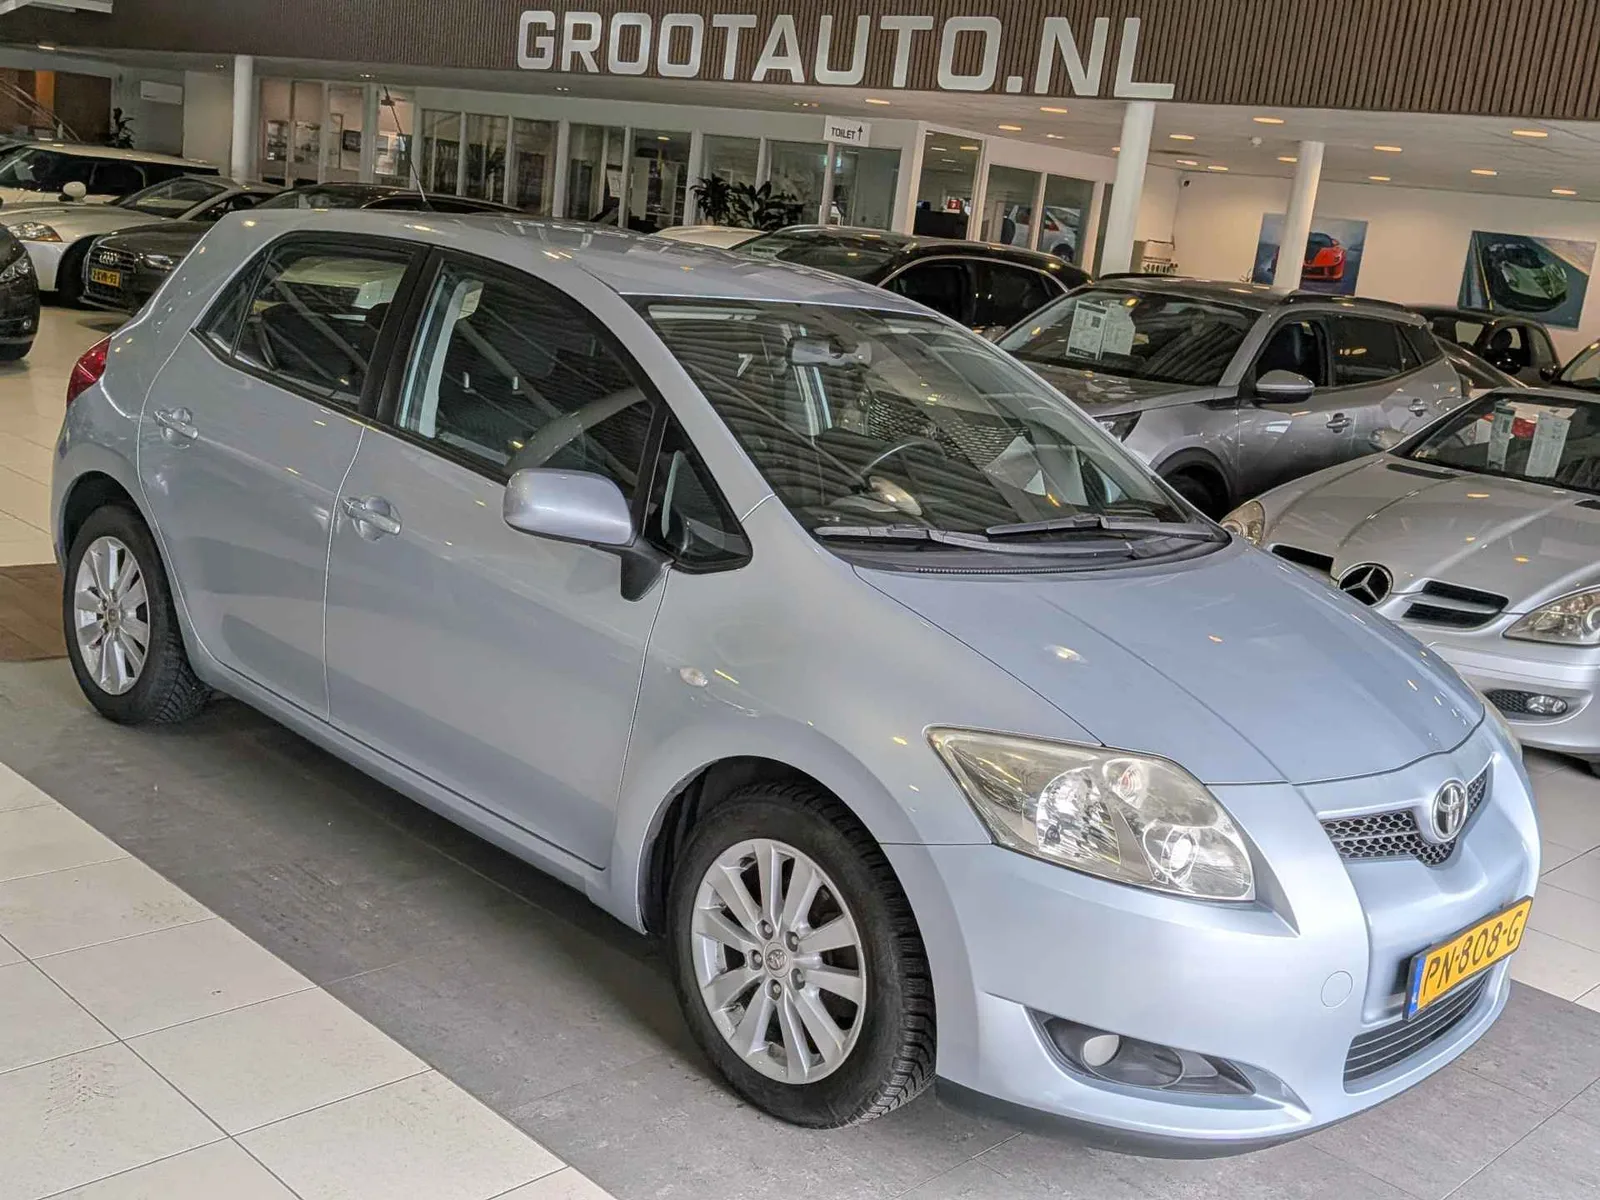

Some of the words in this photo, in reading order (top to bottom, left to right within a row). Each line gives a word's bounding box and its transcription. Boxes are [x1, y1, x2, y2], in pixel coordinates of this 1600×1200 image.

[517, 10, 1175, 100] GROOTAUTO.NL
[831, 126, 856, 140] TOILET
[1423, 910, 1523, 996] PN-808-G
